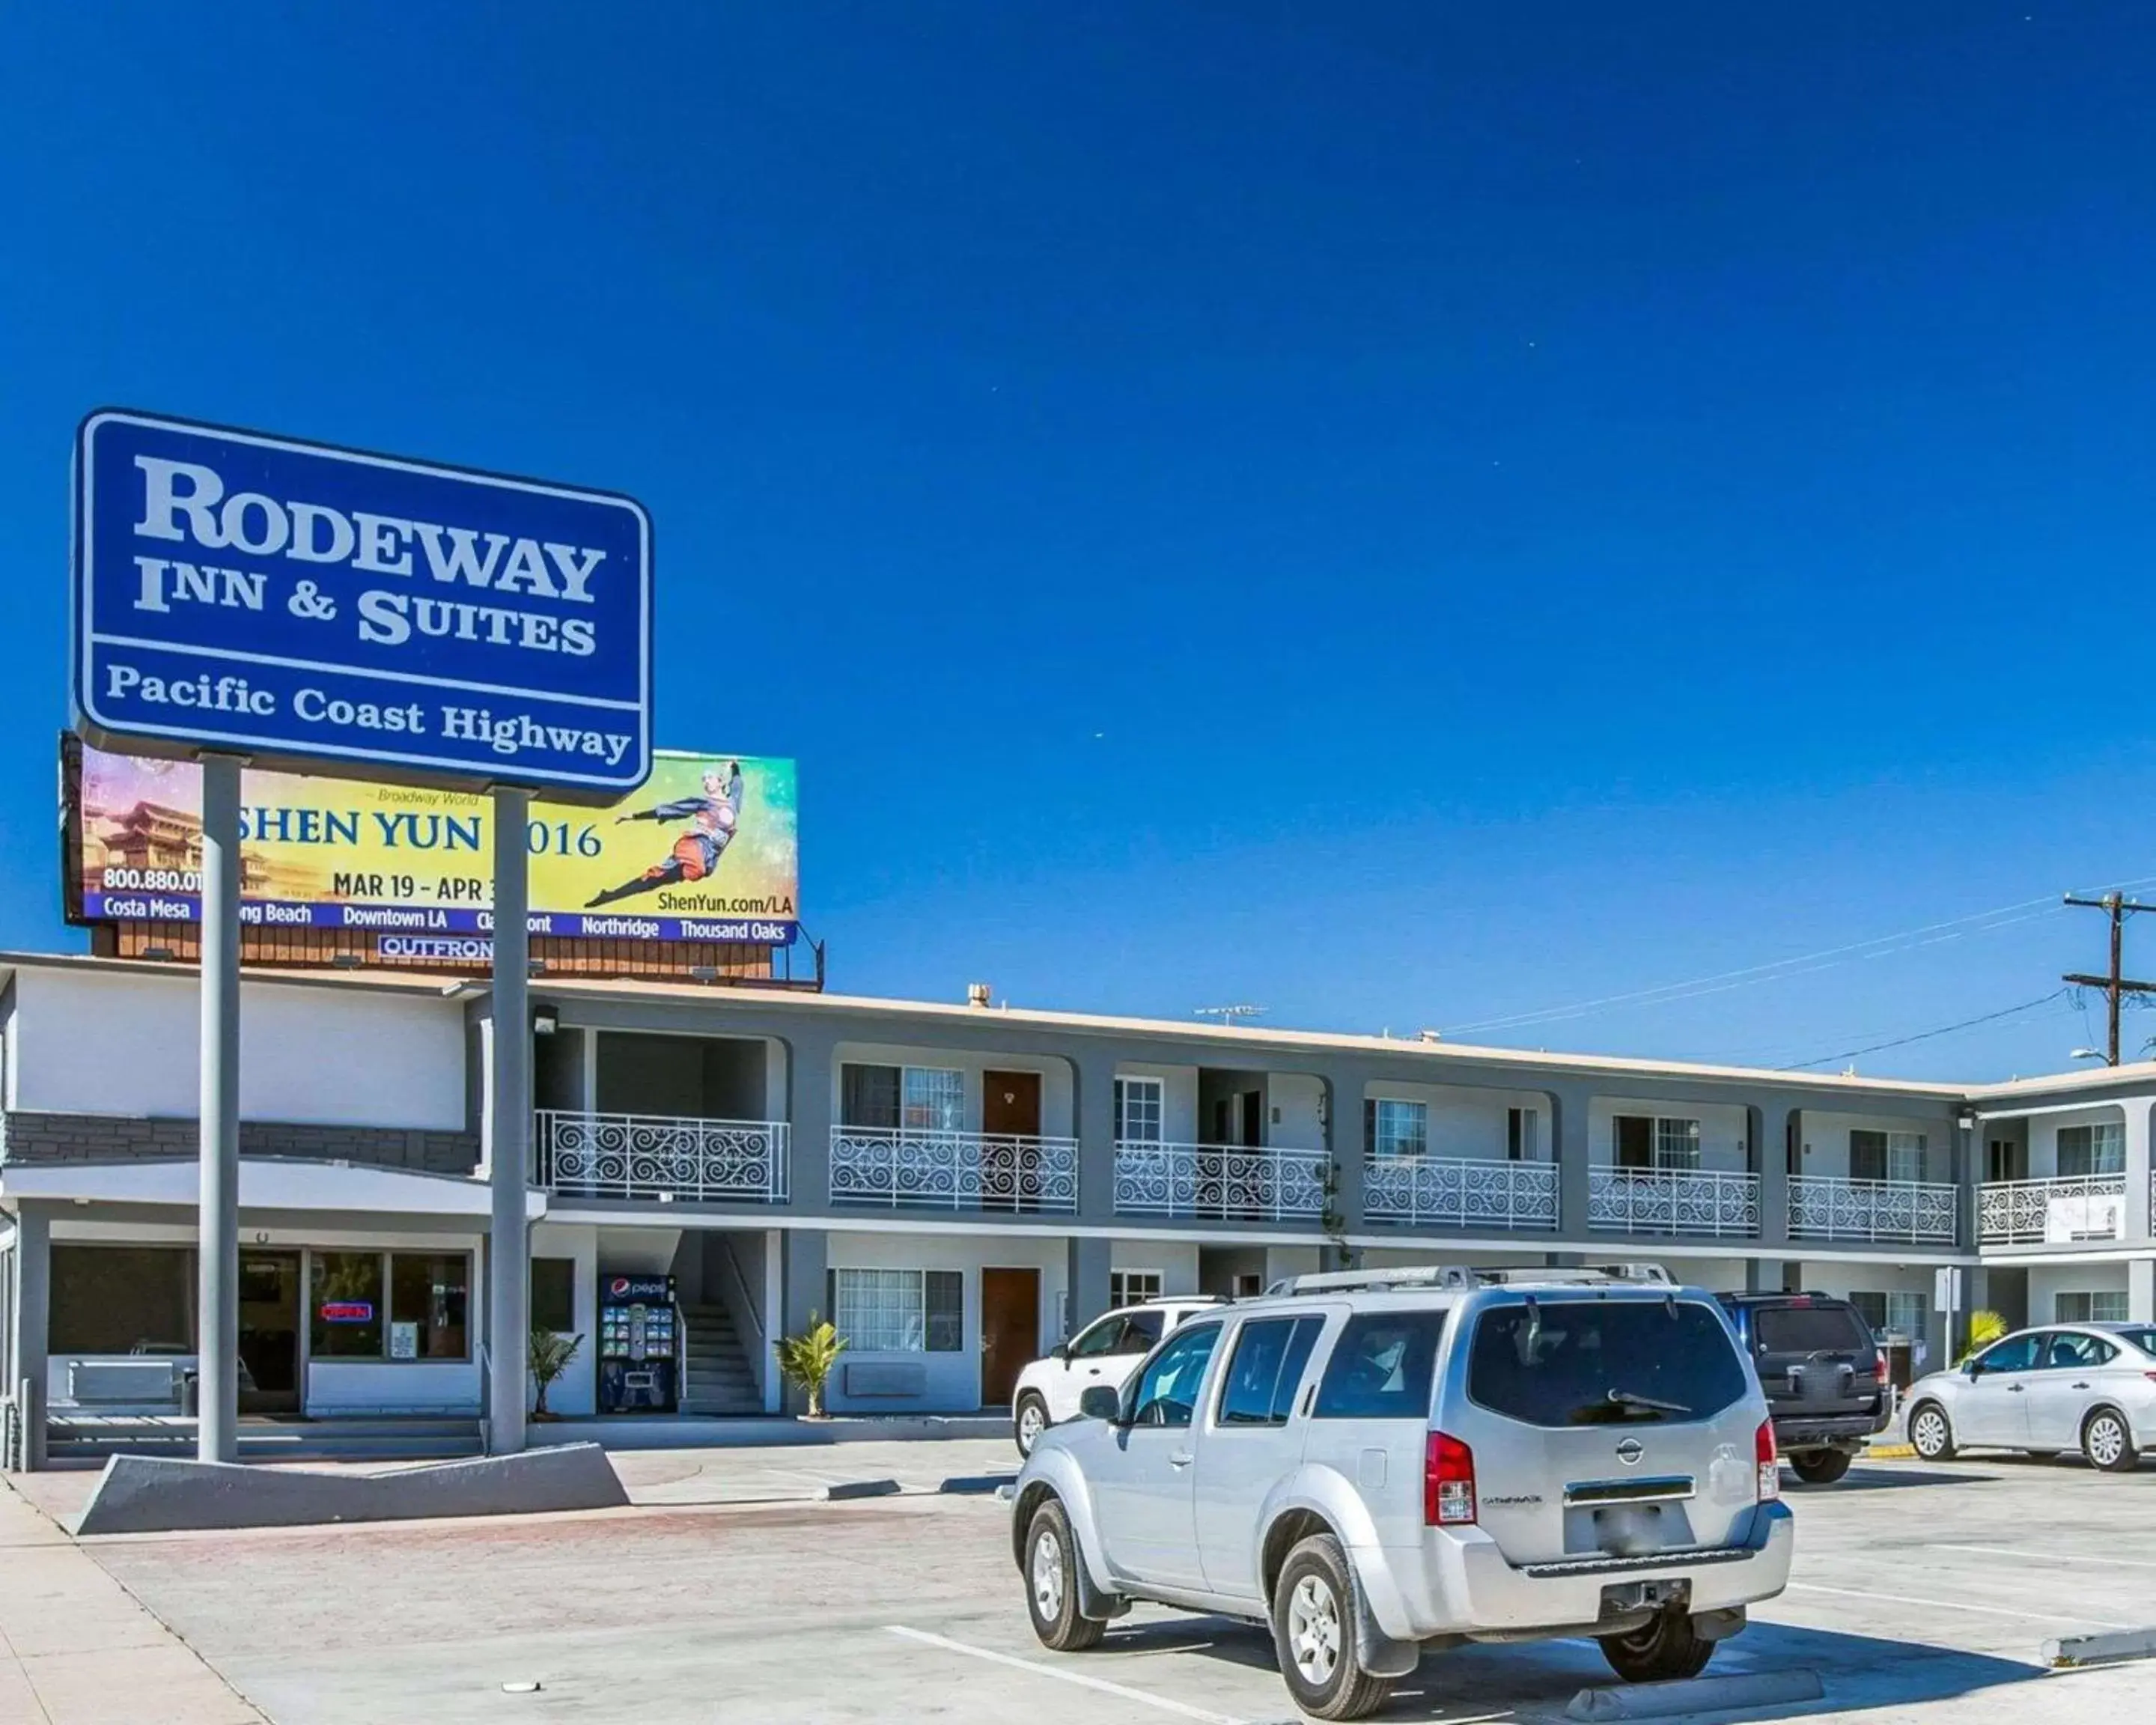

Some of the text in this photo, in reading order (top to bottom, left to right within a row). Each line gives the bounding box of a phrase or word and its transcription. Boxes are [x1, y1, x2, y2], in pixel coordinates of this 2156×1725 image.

[135, 455, 606, 602] RODEWAY
[135, 556, 596, 656] INN & SUITES
[107, 665, 631, 765] Pacific Coast Highway
[378, 788, 439, 806] Broadway
[443, 792, 479, 806] World
[373, 812, 482, 851] YUN
[527, 821, 602, 857] 016
[103, 868, 202, 892] 800.880.01
[334, 872, 383, 897] MAR
[391, 874, 414, 898] 19
[437, 877, 482, 901] APR
[104, 898, 190, 919] Costa Mesa
[658, 892, 794, 914] ShenYun.com/LA
[240, 903, 312, 925] ng Beach
[344, 907, 448, 928] Downtown LA
[582, 916, 660, 937] Northridge
[680, 920, 786, 940] Thousand Oaks
[384, 938, 494, 958] OUTFRON
[632, 1283, 666, 1294] pepsi
[322, 1306, 368, 1318] OPEN
